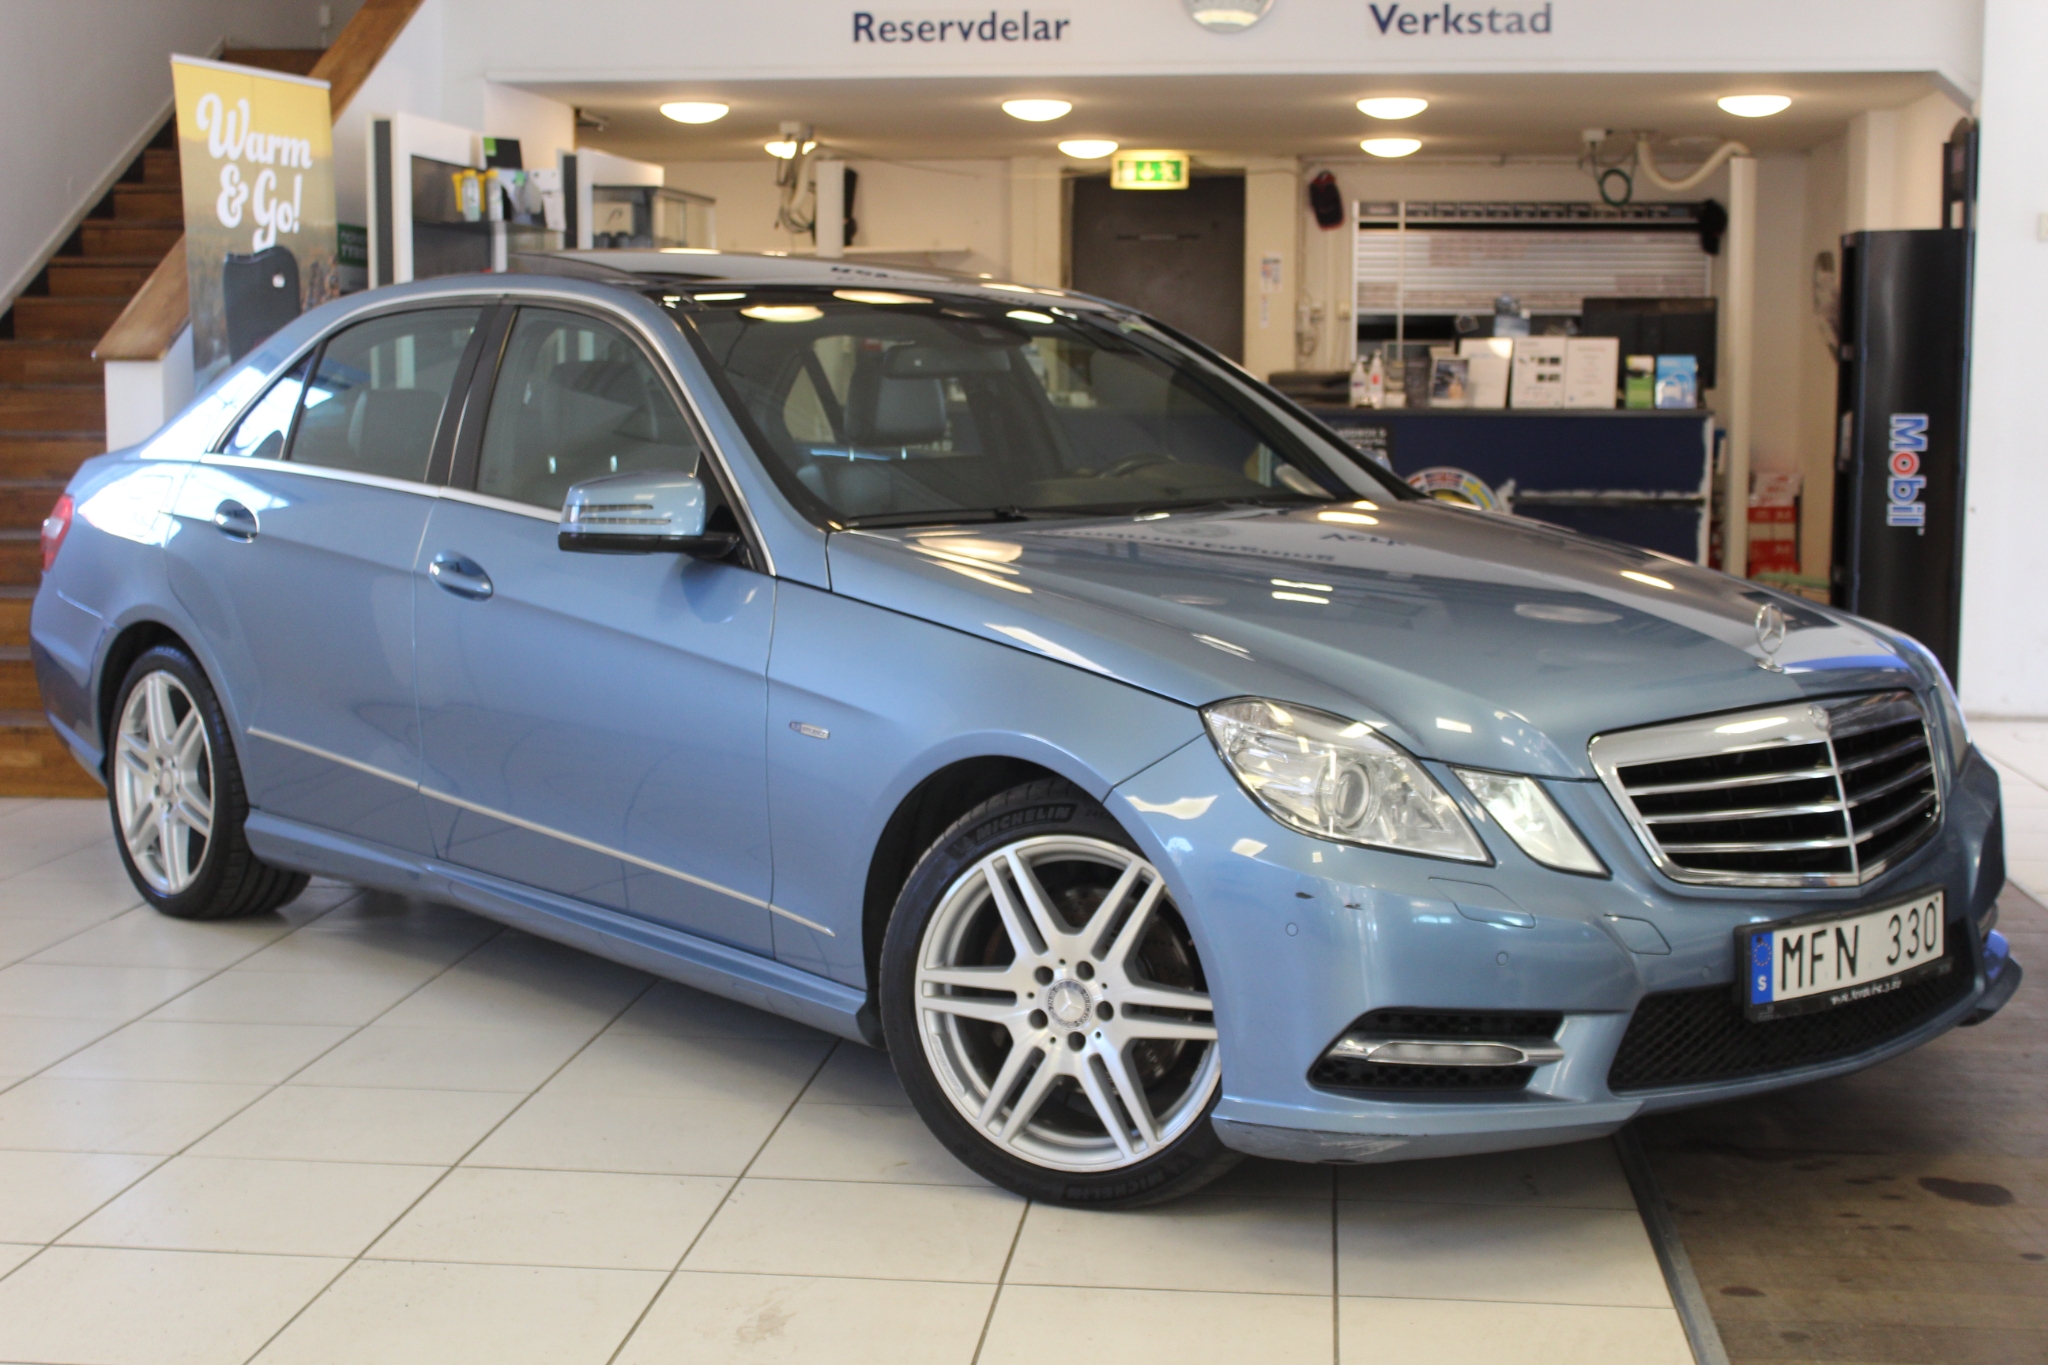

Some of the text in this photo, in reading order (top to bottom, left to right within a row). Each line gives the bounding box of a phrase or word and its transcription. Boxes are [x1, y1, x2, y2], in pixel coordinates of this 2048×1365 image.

[853, 10, 1070, 43] Reservdelar
[1369, 2, 1552, 36] Verkstad
[196, 92, 314, 170] Warm
[216, 162, 303, 253] & Go!
[1886, 413, 1929, 527] Mobil
[974, 804, 1072, 842] MICHELIN
[1781, 901, 1937, 992] MFN 330
[1757, 975, 1767, 992] S
